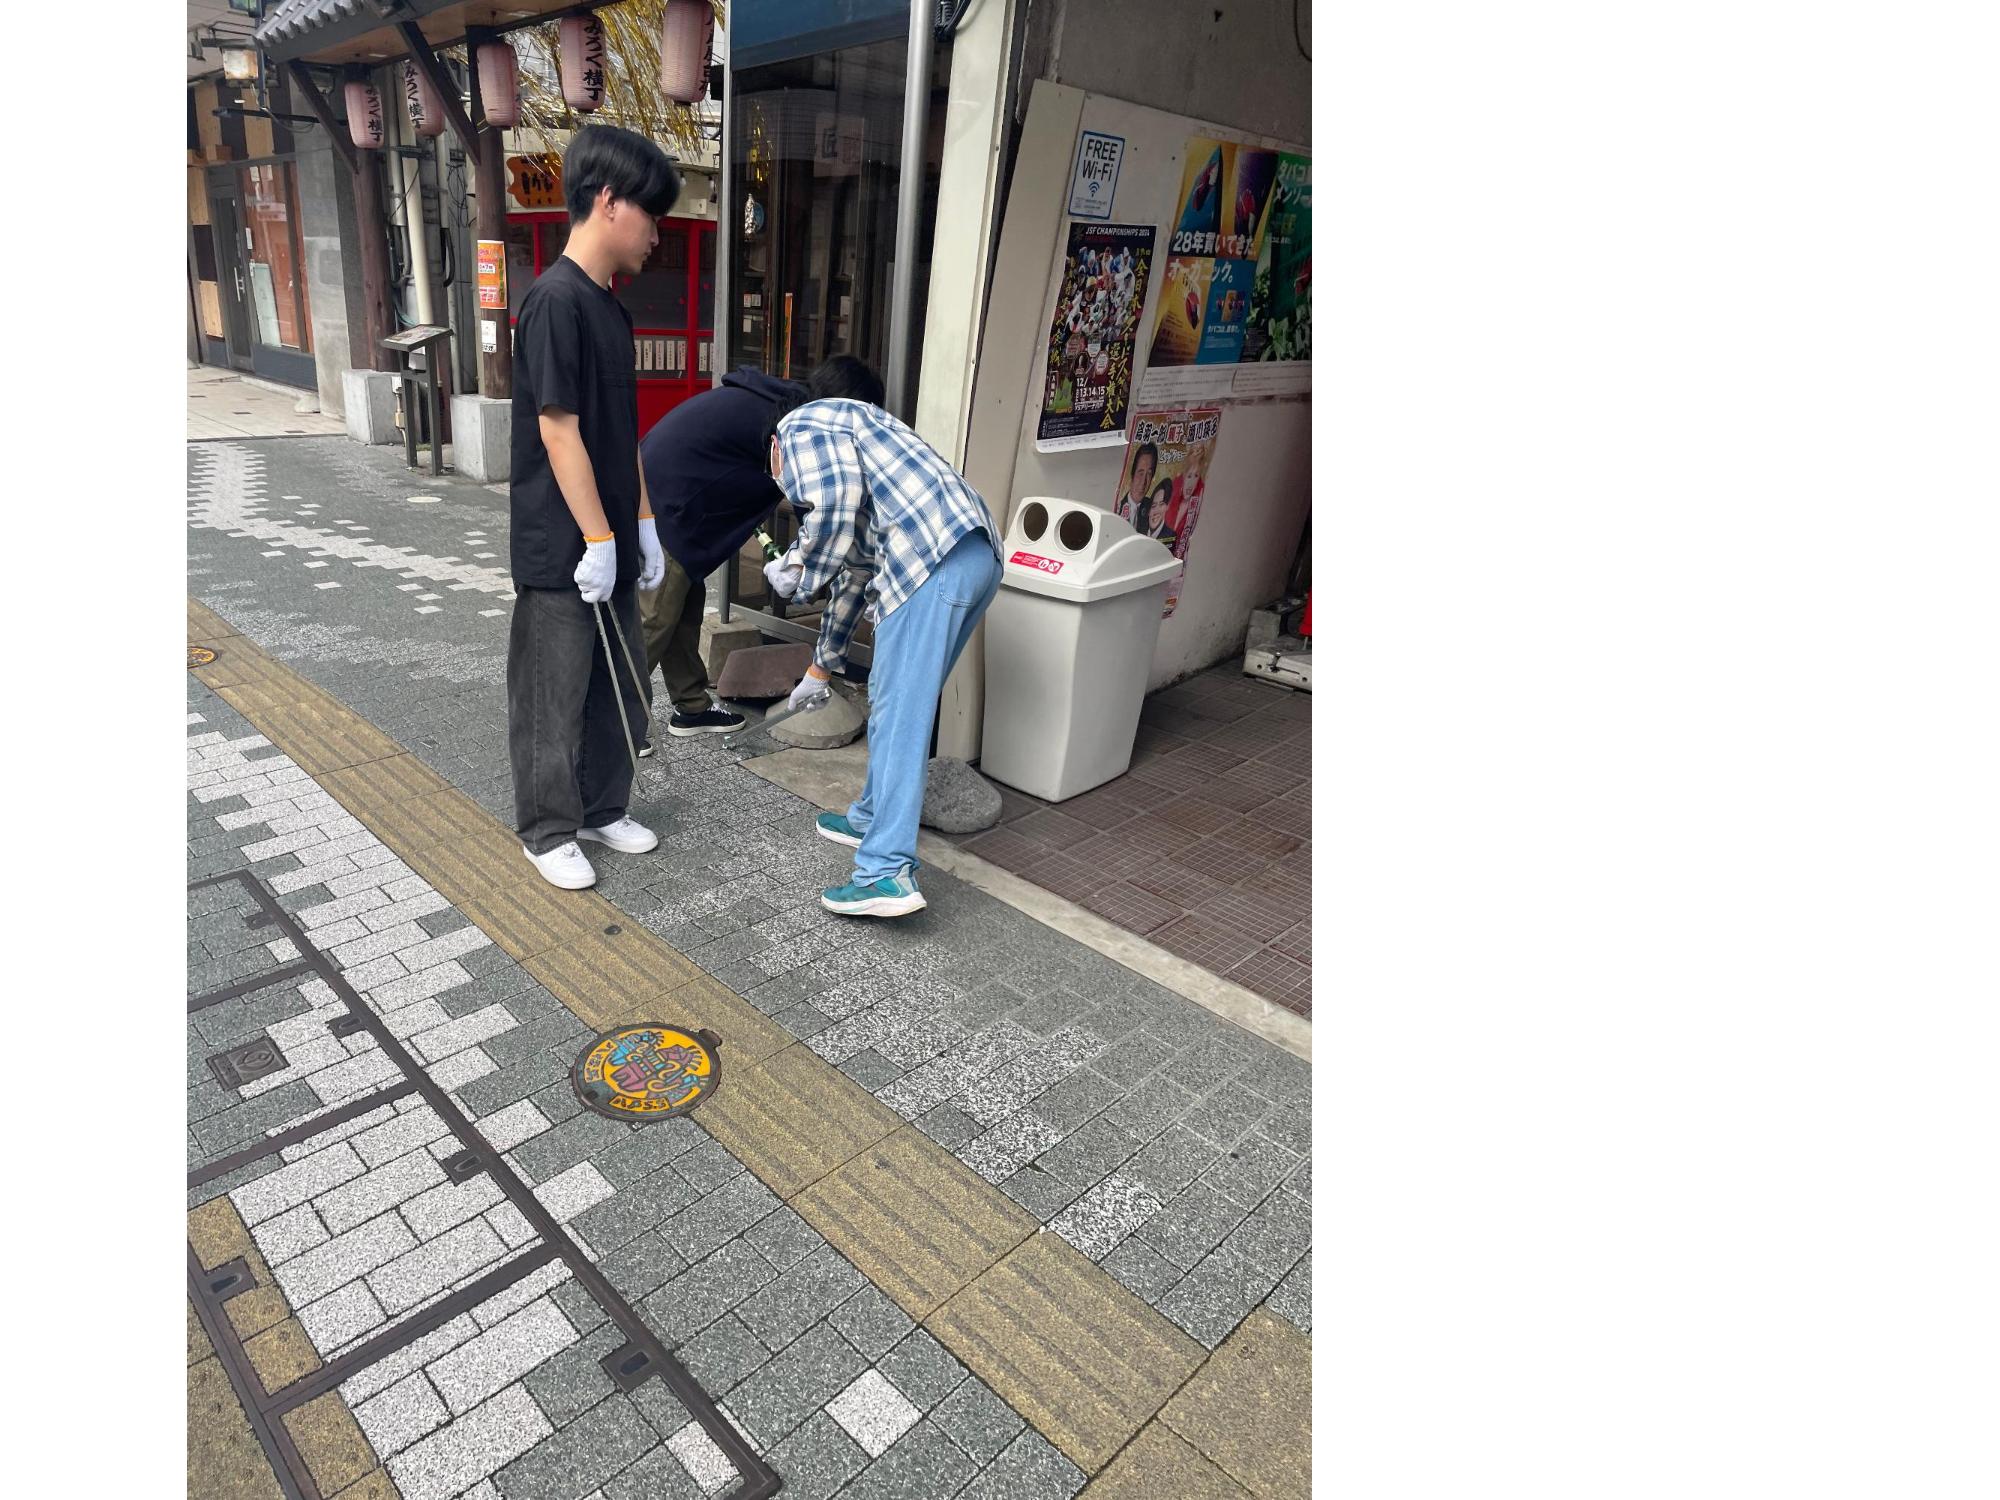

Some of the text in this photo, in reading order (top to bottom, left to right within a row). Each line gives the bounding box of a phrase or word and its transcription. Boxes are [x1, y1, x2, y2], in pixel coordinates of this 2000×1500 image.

[583, 18, 604, 101] みろく横丁
[405, 63, 424, 128] みろく横丁
[366, 83, 383, 142] みろく横丁
[1086, 139, 1118, 161] FREE
[1082, 160, 1114, 182] Wi-Fi
[1278, 160, 1312, 183] タバコ
[1086, 227, 1096, 235] JSF
[1097, 227, 1138, 236] CHAMPIONSHIPS
